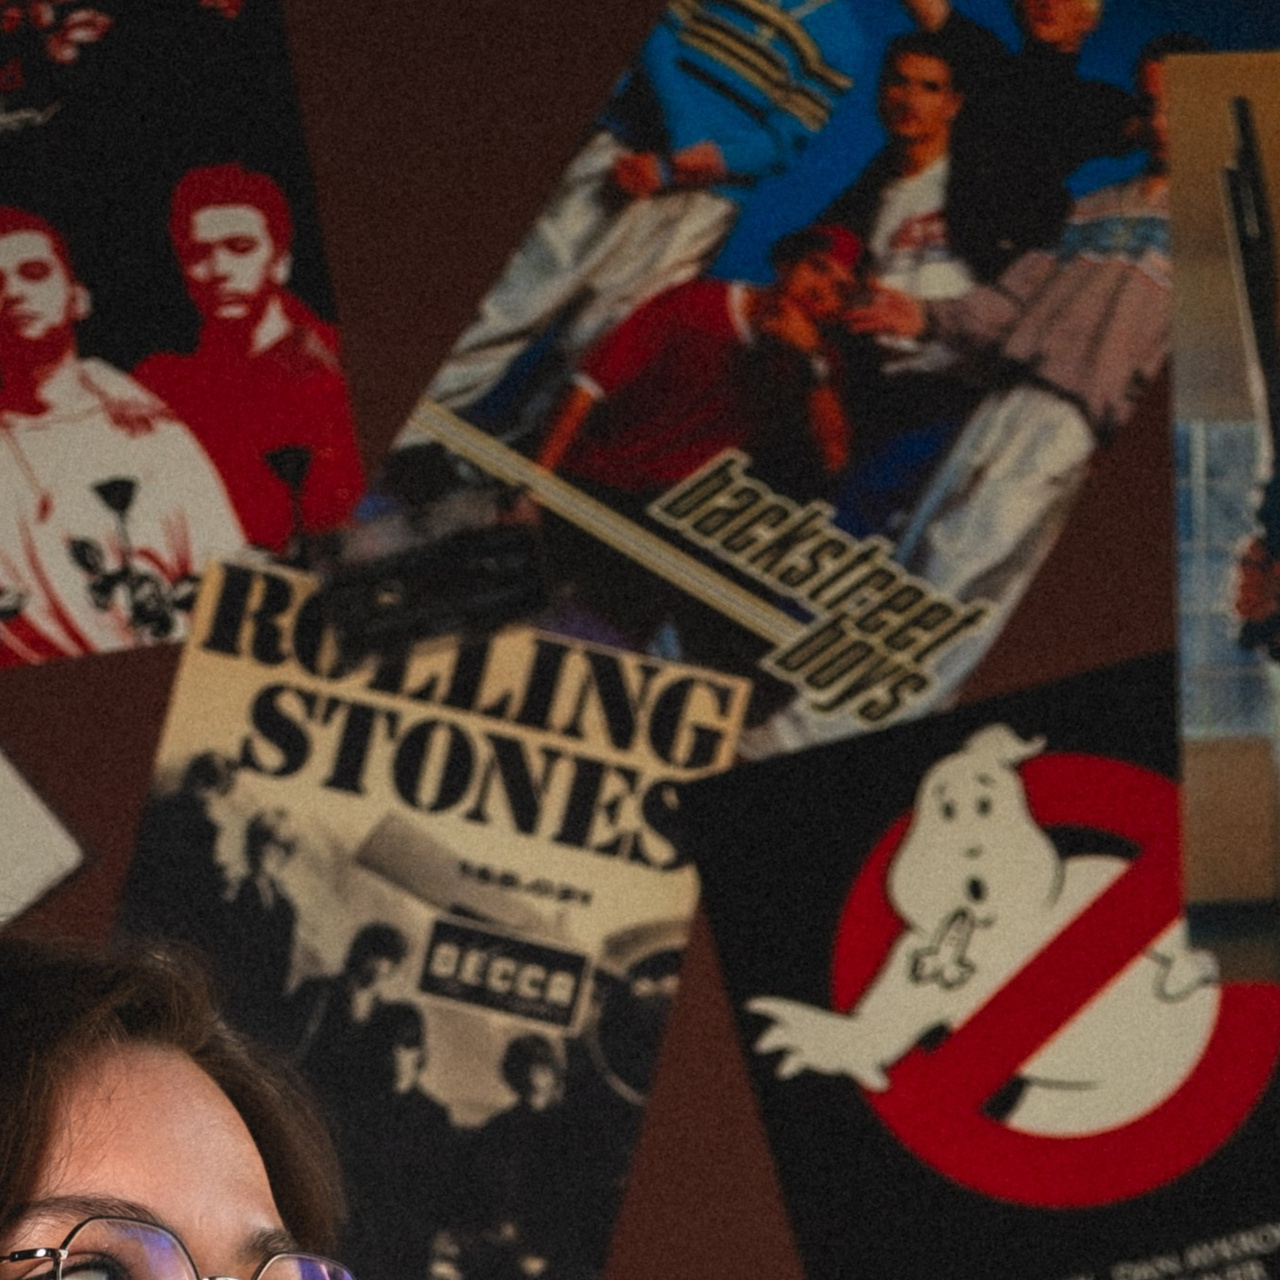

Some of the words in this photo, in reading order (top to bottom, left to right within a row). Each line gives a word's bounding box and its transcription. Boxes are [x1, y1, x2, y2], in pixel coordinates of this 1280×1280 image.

[656, 452, 988, 668] backstreet
[768, 608, 932, 726] boys
[238, 682, 684, 872] STONES
[428, 941, 580, 1011] DECCA
